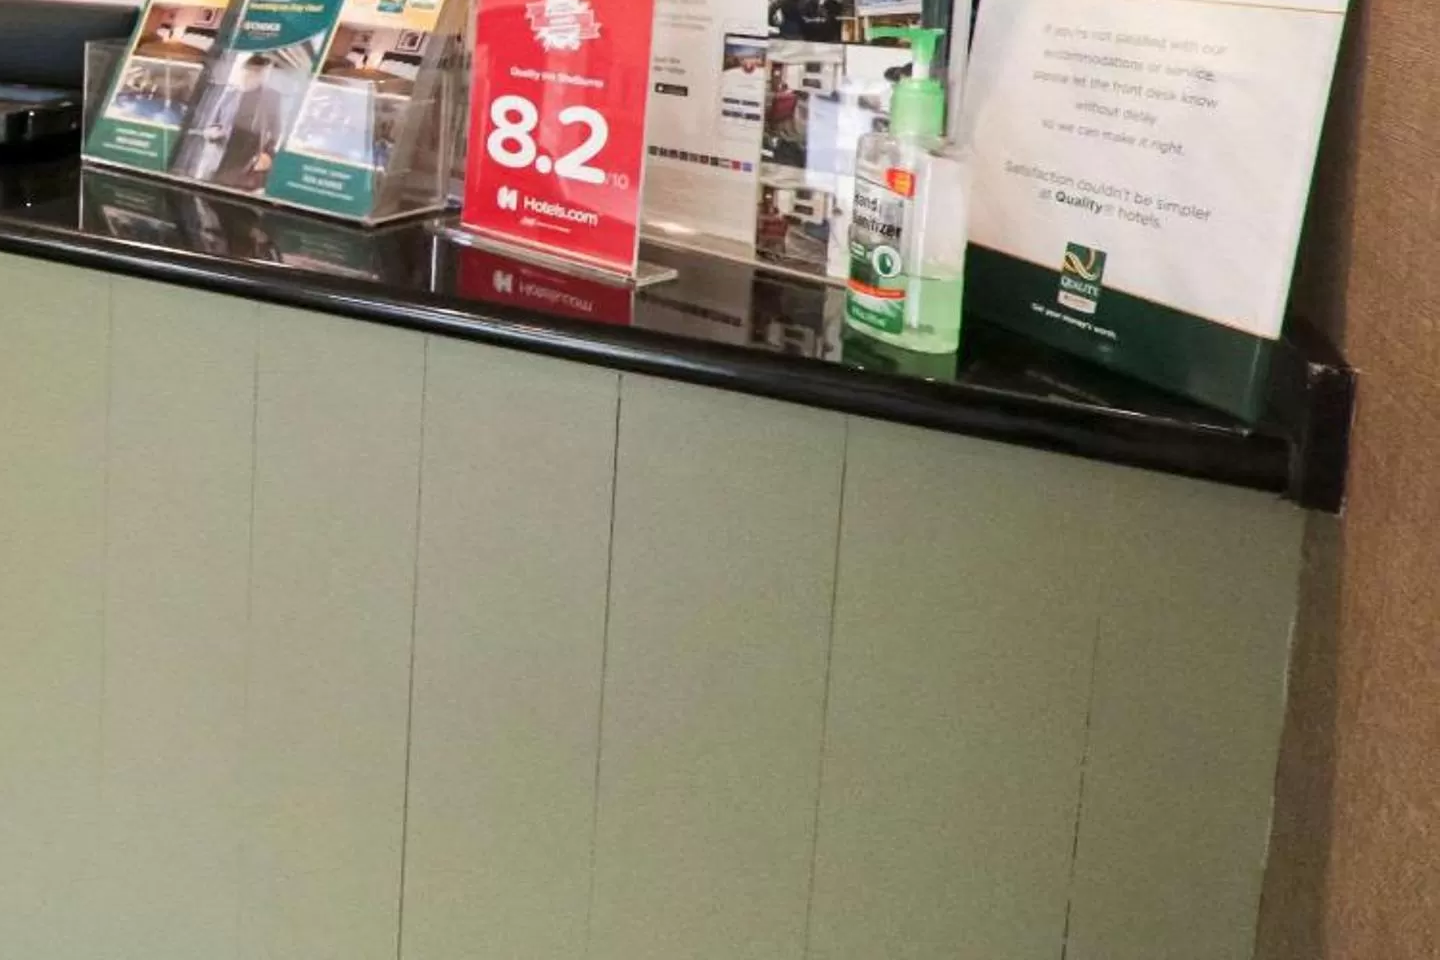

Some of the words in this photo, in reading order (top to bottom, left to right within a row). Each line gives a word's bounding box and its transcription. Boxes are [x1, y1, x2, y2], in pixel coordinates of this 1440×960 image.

[486, 94, 610, 184] 8.2
[523, 195, 599, 227] Hotels.com
[1134, 192, 1153, 206] be
